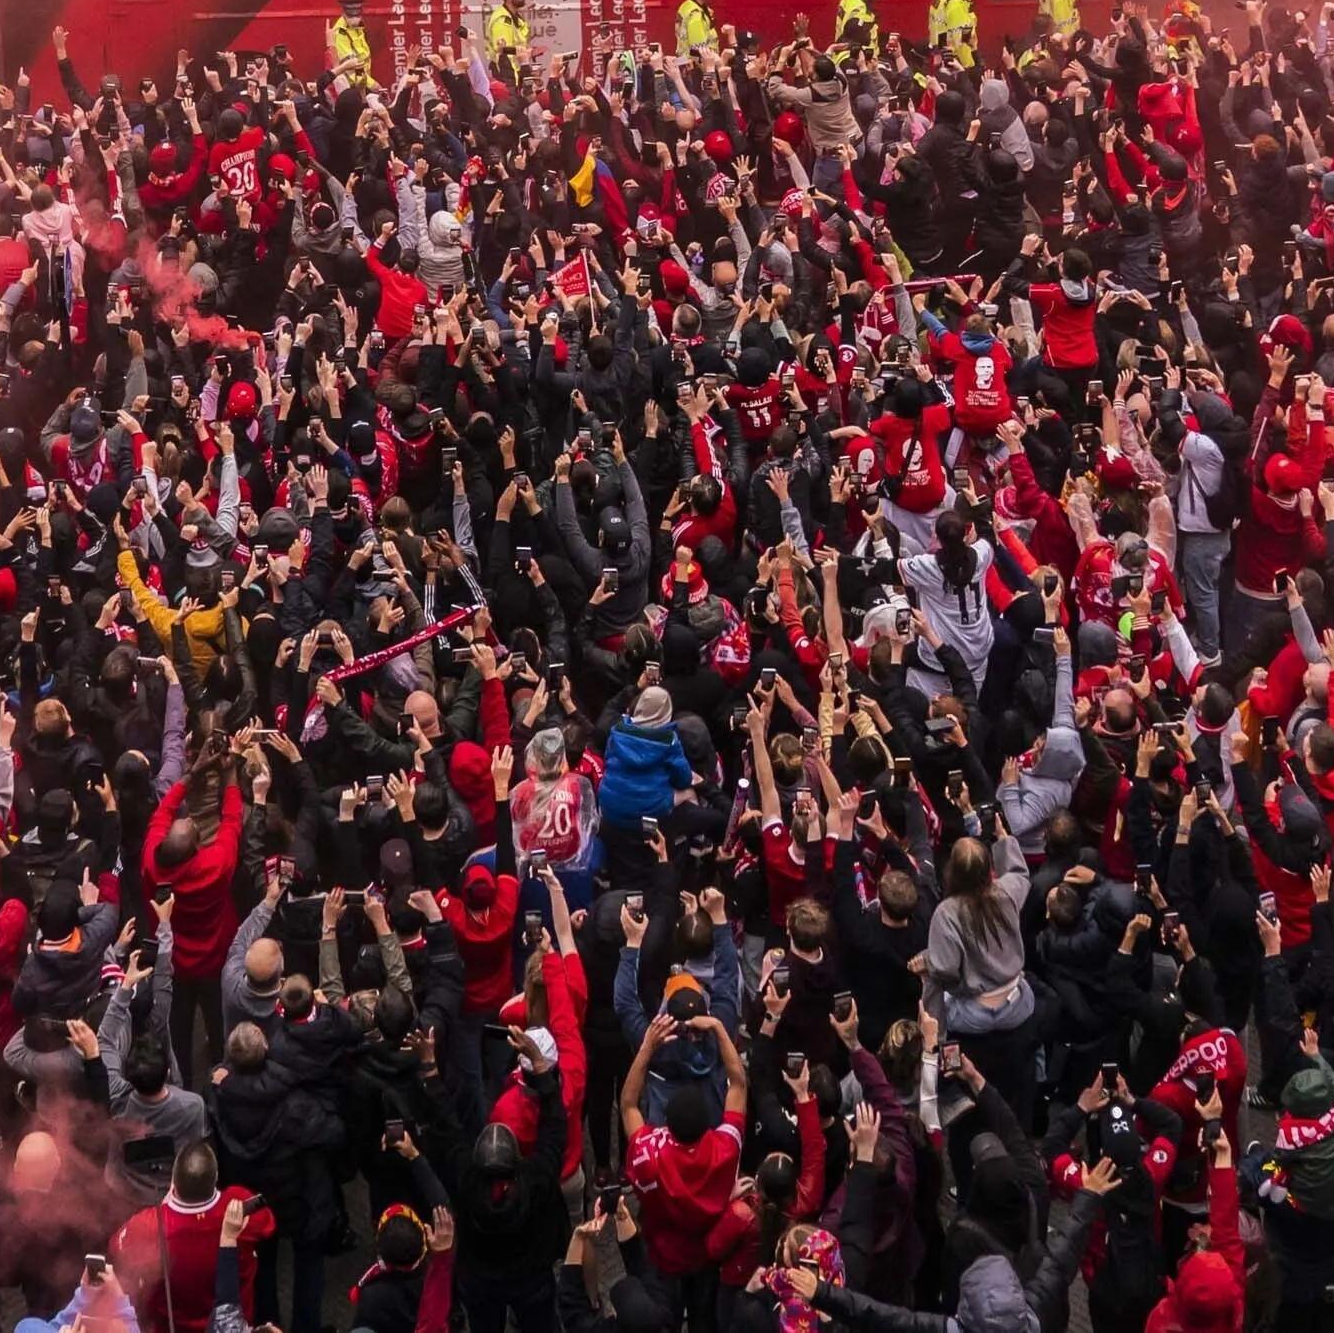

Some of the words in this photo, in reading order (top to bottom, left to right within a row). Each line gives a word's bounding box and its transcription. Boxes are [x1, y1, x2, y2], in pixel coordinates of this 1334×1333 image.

[227, 161, 255, 195] 20
[747, 406, 772, 427] 11
[537, 803, 572, 839] 20
